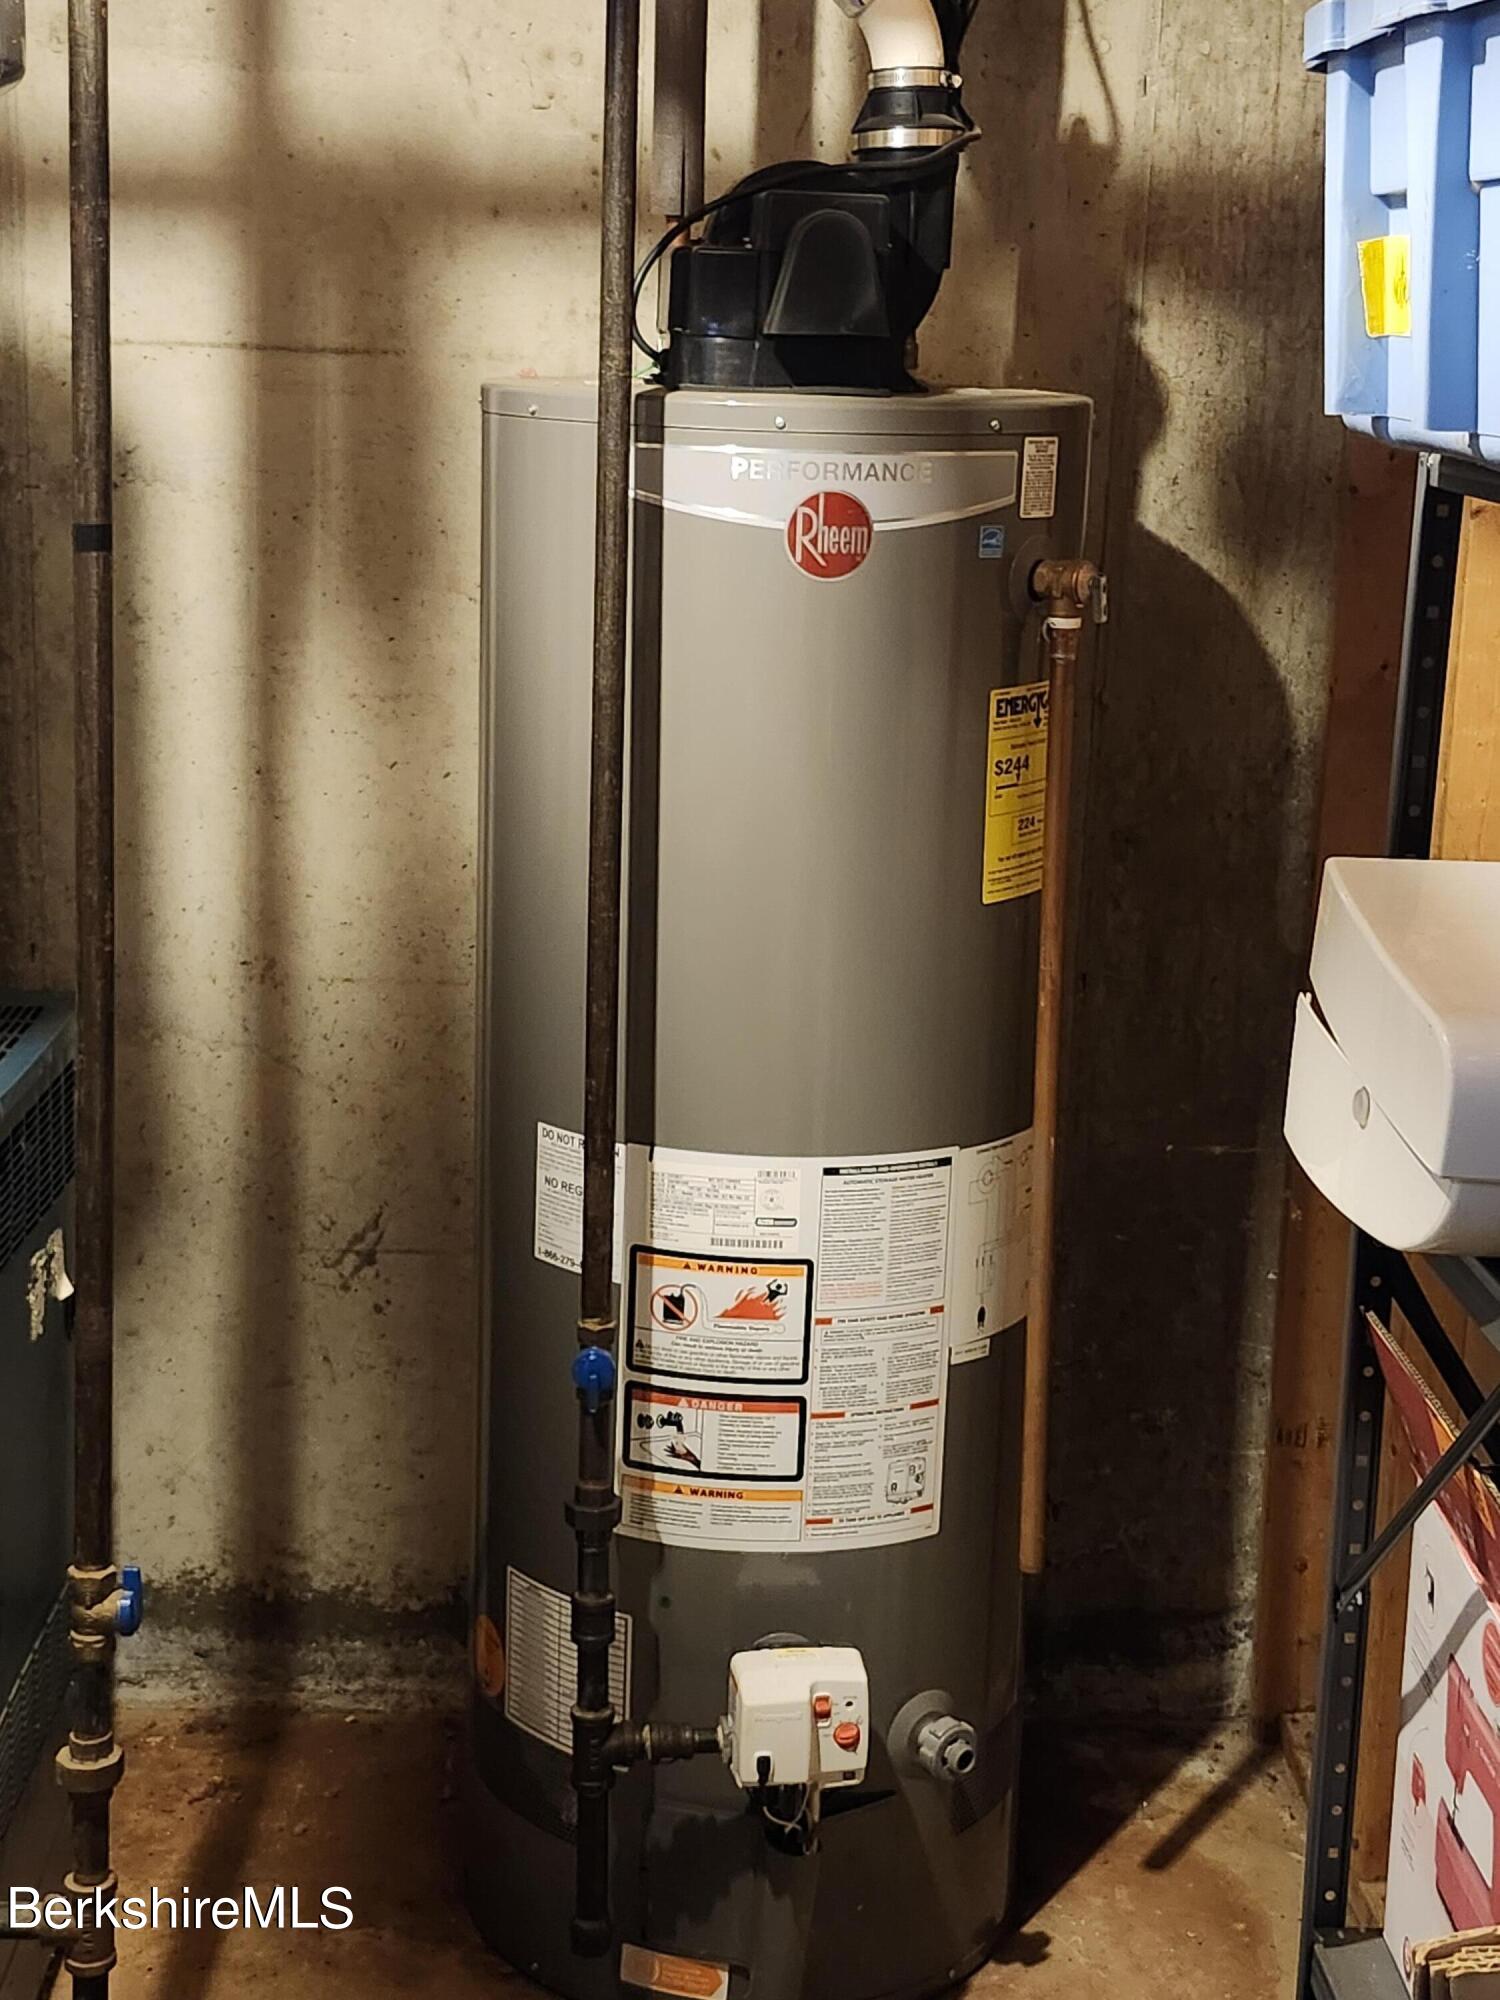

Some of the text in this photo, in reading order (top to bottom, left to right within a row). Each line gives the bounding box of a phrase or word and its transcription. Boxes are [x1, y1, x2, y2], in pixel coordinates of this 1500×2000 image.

[730, 455, 933, 482] PERFORMANCE
[795, 492, 868, 567] Rheem
[542, 1127, 554, 1140] DO
[557, 1132, 575, 1147] NOT
[544, 1175, 559, 1188] NO
[696, 1263, 759, 1275] WARNING
[692, 1400, 743, 1412] DANGER
[690, 1487, 744, 1500] WARNING
